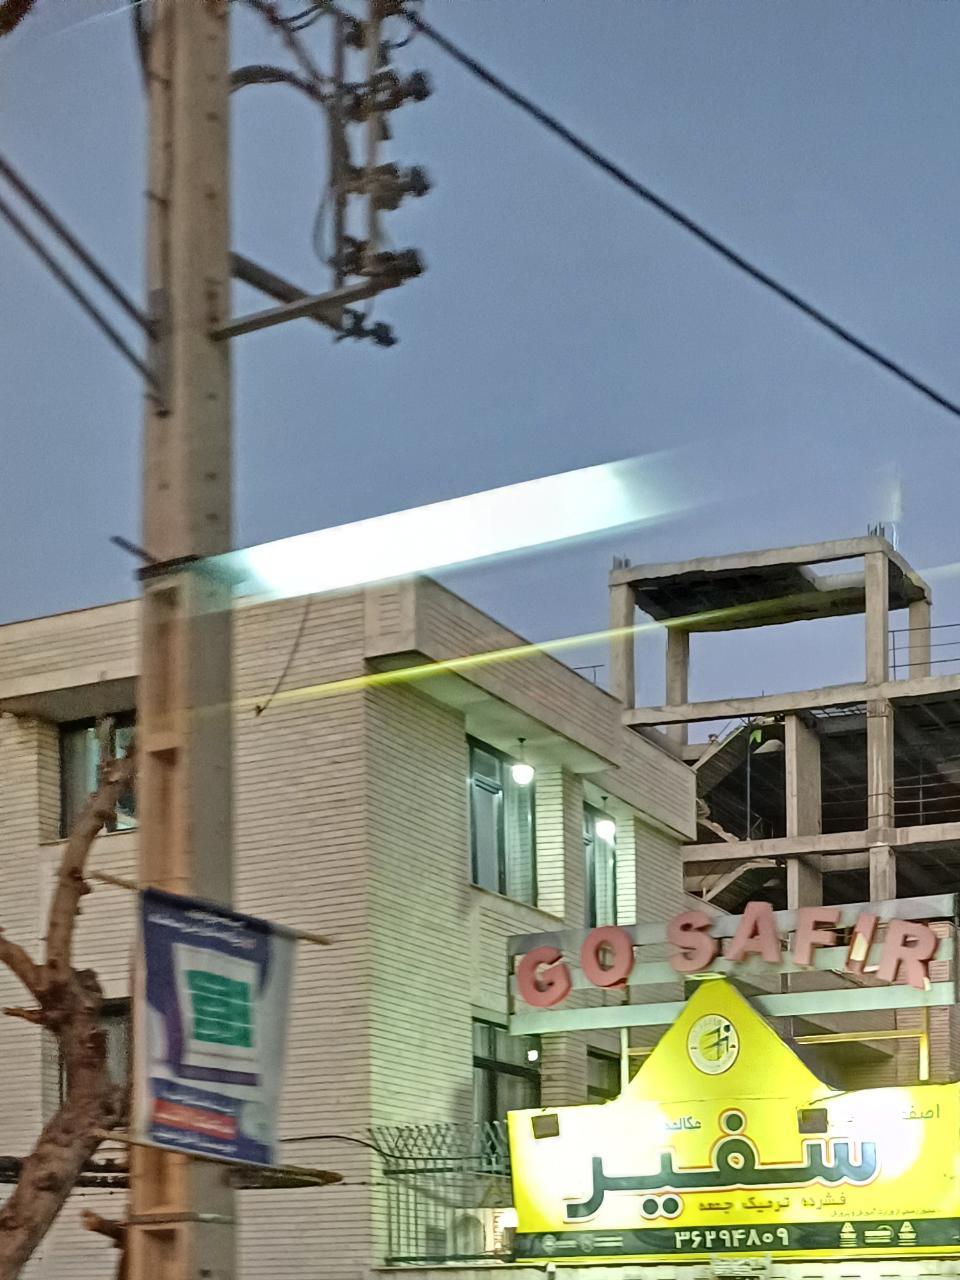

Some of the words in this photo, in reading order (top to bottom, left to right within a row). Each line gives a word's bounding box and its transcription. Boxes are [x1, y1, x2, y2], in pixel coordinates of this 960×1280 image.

[517, 925, 636, 1008] GO
[667, 901, 939, 991] SAFIR
[563, 1109, 880, 1222] سفیر
[800, 1191, 847, 1210] فشرده
[674, 1226, 790, 1250] ۳۶۲۹۴۸۰۹
